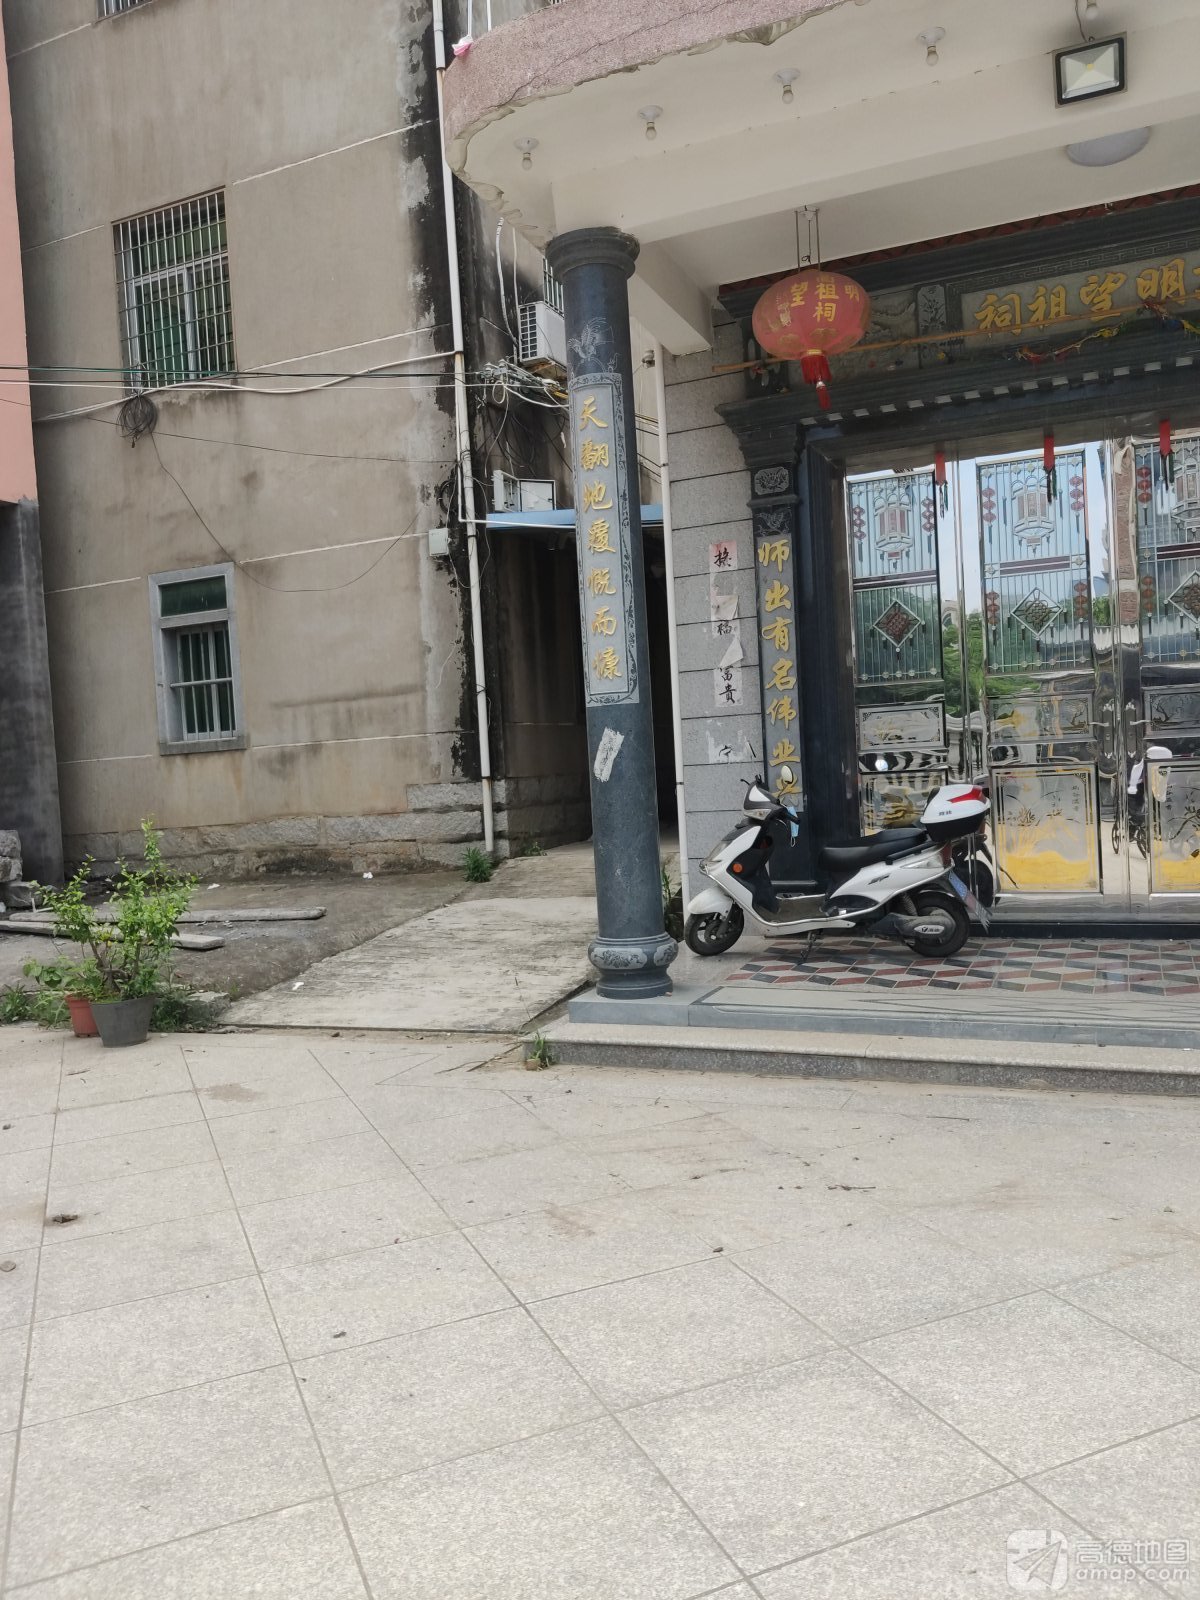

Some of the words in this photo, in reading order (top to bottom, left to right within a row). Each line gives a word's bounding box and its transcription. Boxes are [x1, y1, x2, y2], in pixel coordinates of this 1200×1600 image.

[579, 395, 622, 681] 天翻地覆慨而慷
